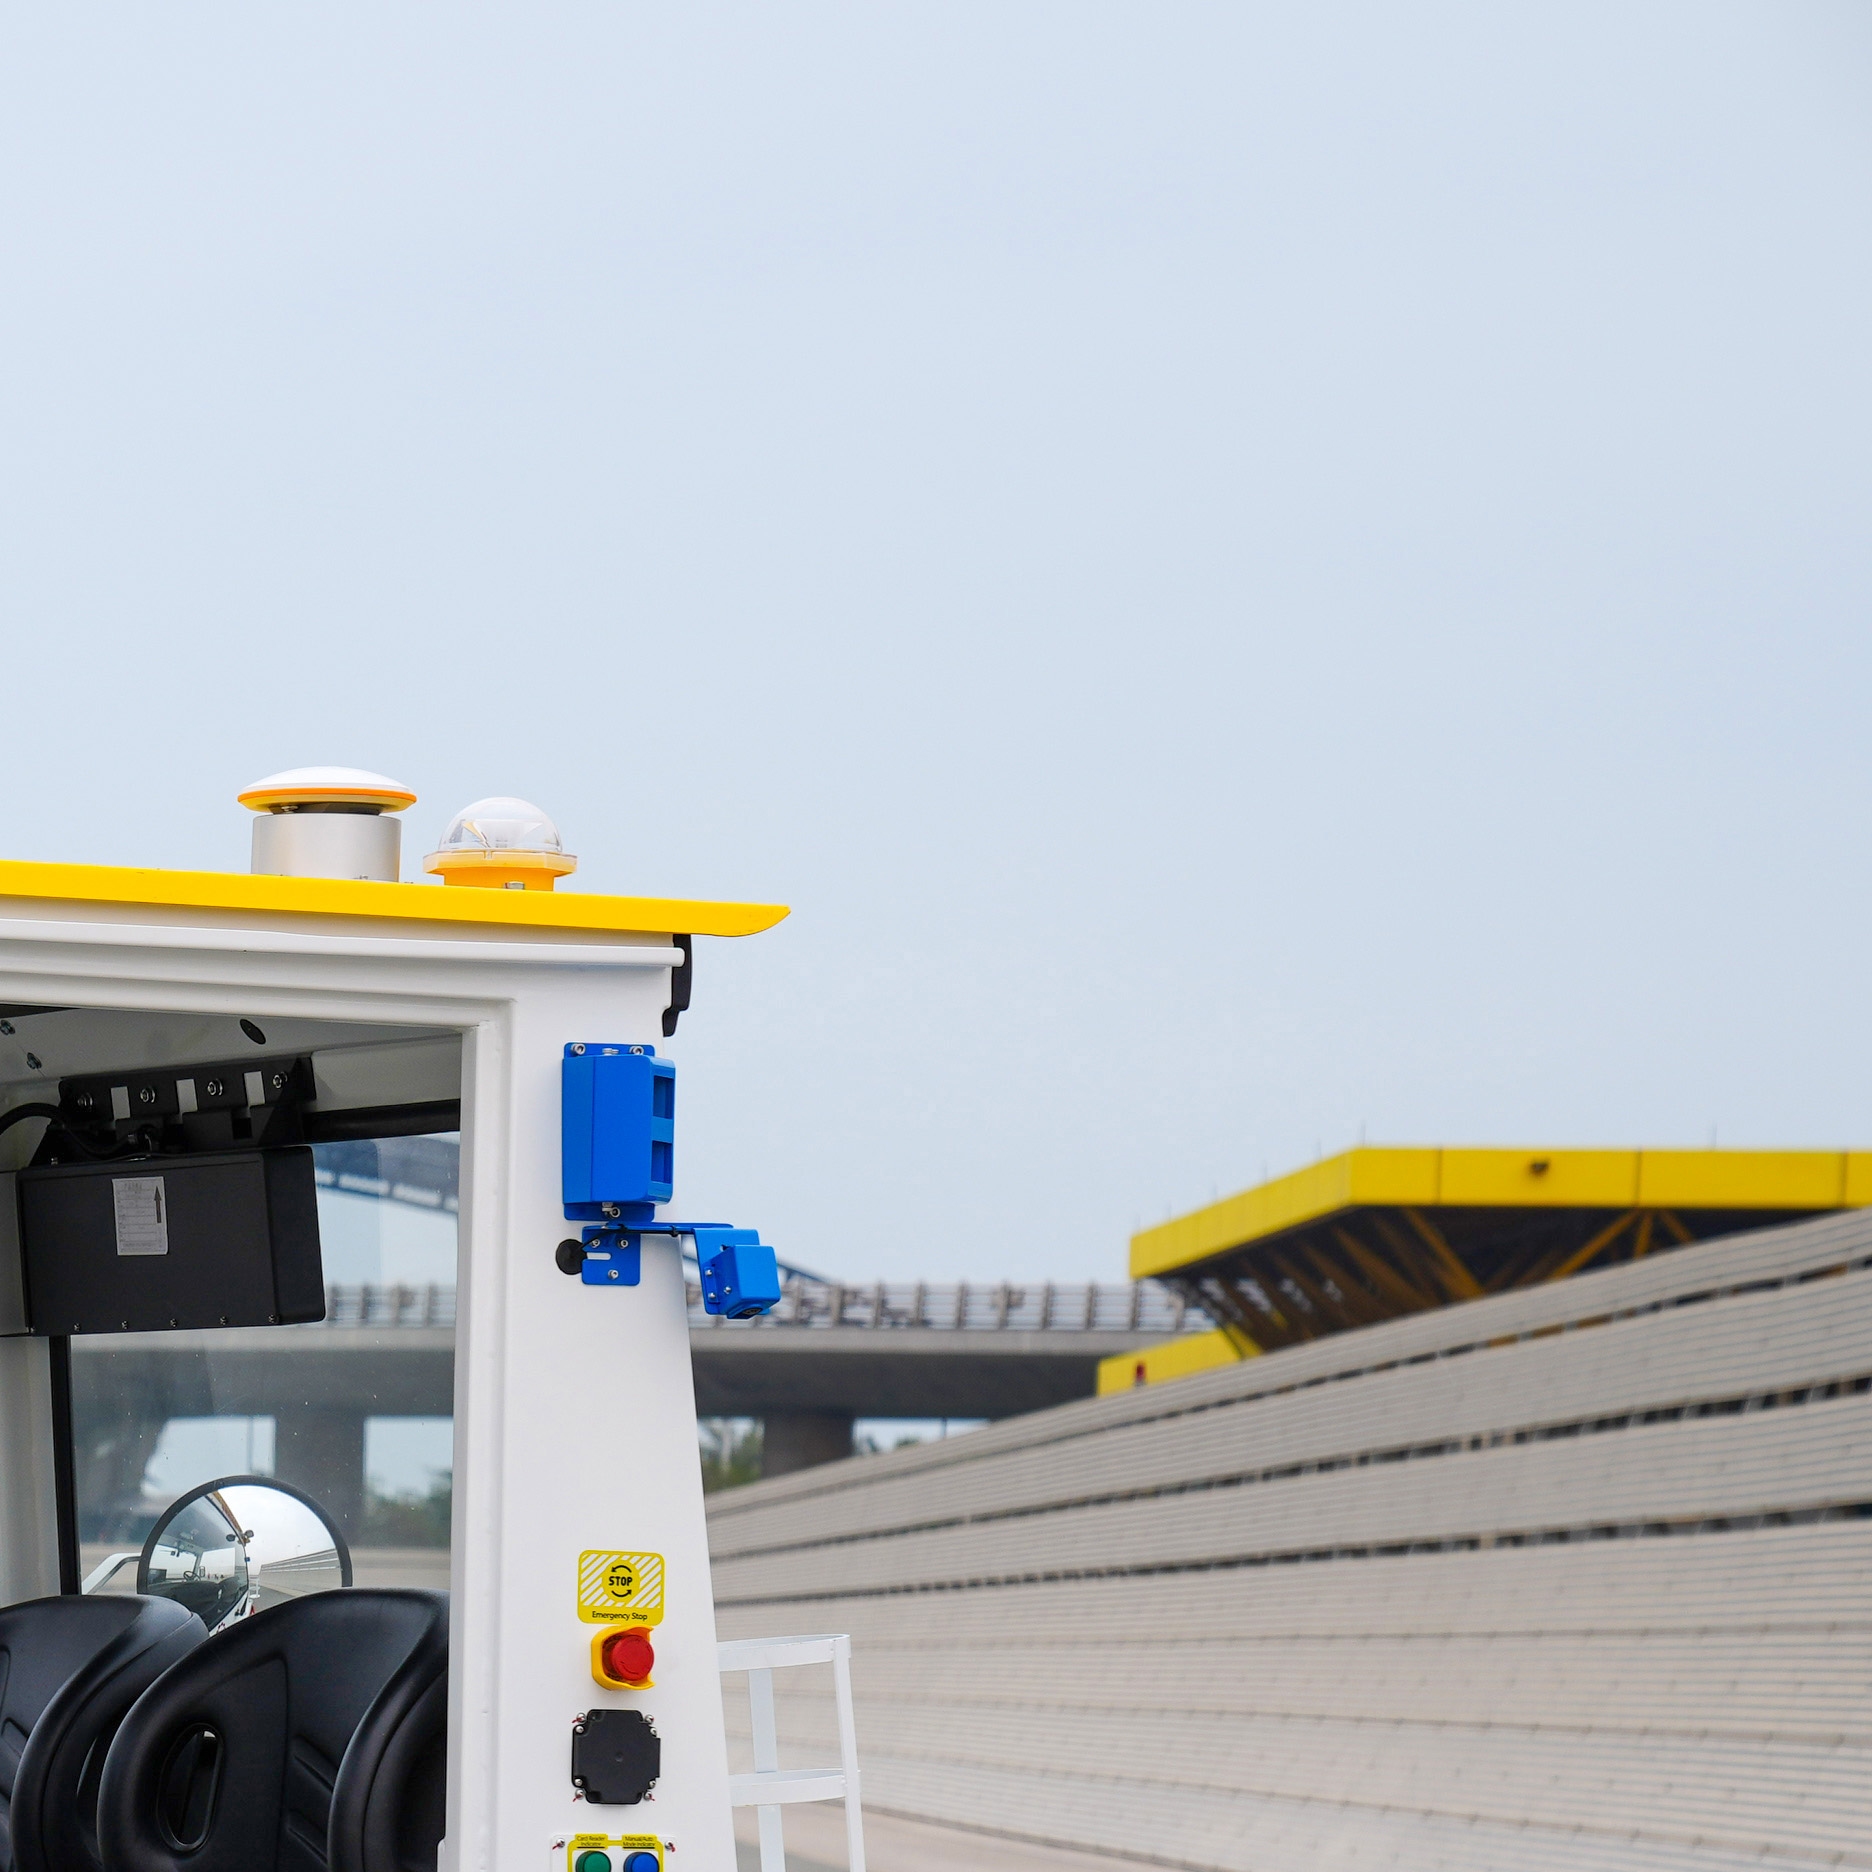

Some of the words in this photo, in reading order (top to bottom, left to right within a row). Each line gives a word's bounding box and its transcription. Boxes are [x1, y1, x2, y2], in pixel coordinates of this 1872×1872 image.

[608, 1576, 633, 1587] STOP
[592, 1610, 631, 1621] Emergency
[631, 1612, 648, 1621] Stop
